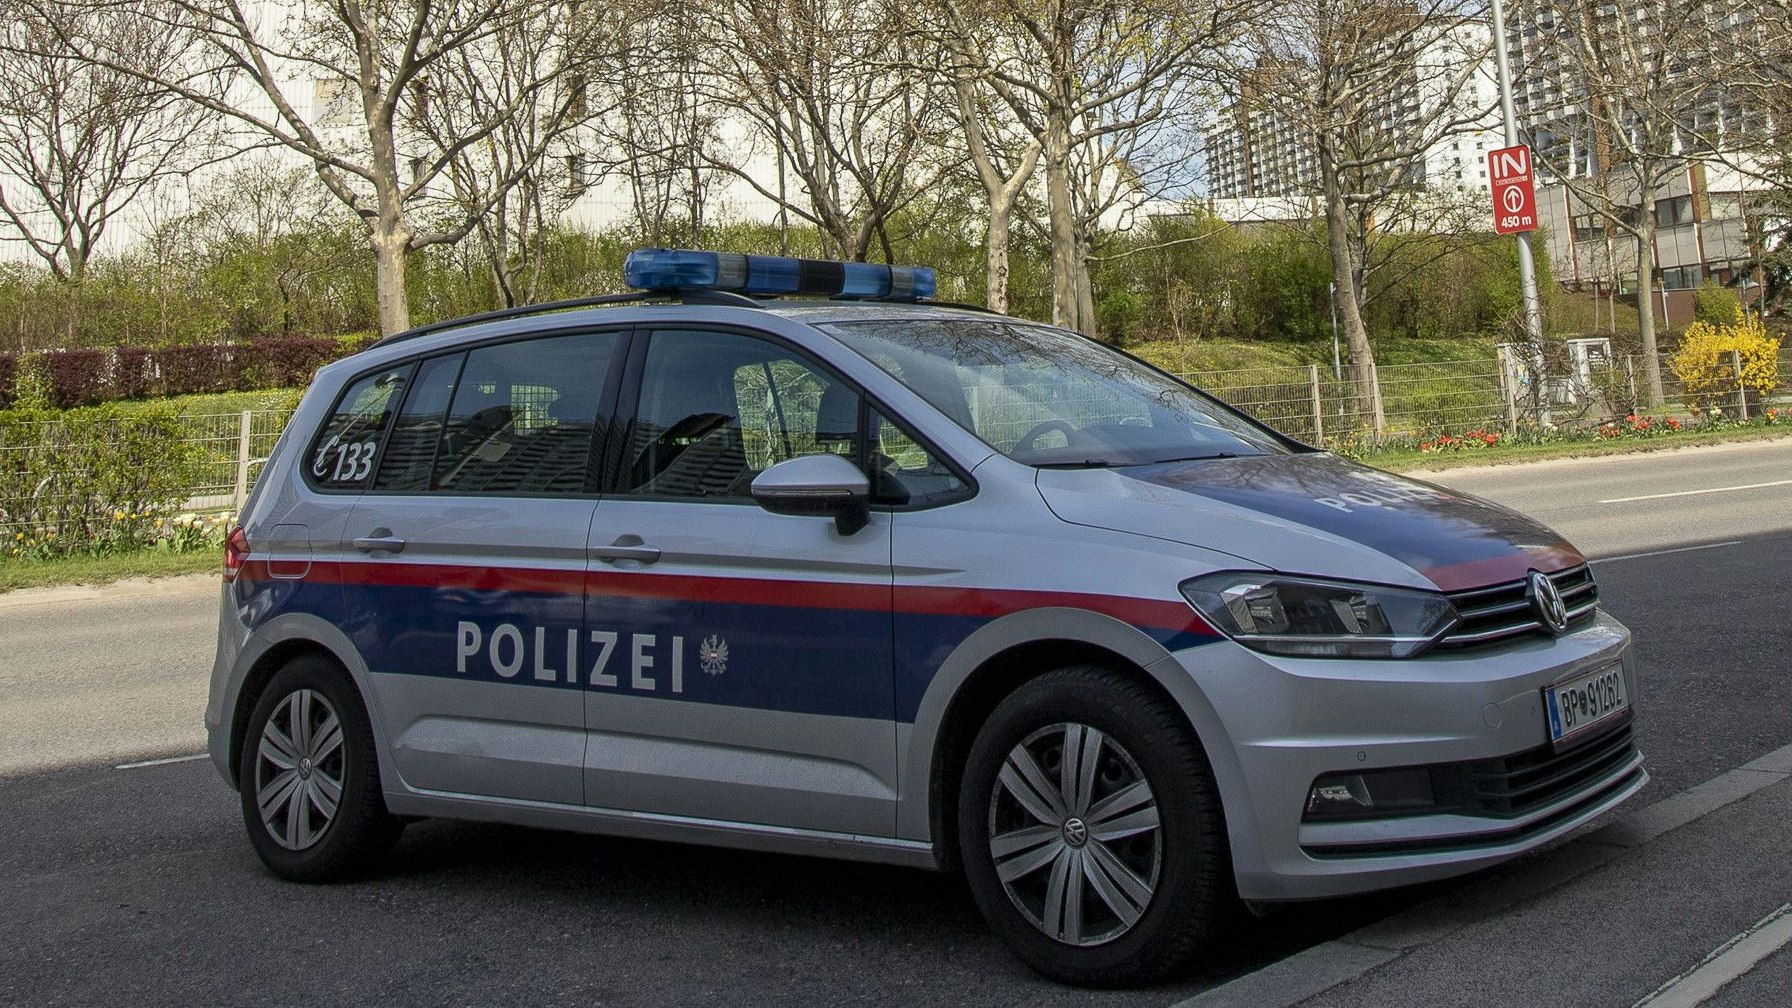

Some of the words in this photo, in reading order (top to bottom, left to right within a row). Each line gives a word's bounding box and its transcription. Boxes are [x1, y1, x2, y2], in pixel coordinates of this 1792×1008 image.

[1493, 149, 1527, 178] IN
[1501, 215, 1520, 228] 450
[1522, 215, 1532, 225] m
[333, 442, 376, 481] 133
[457, 621, 683, 693] POLIZEI
[1561, 688, 1578, 727] BP
